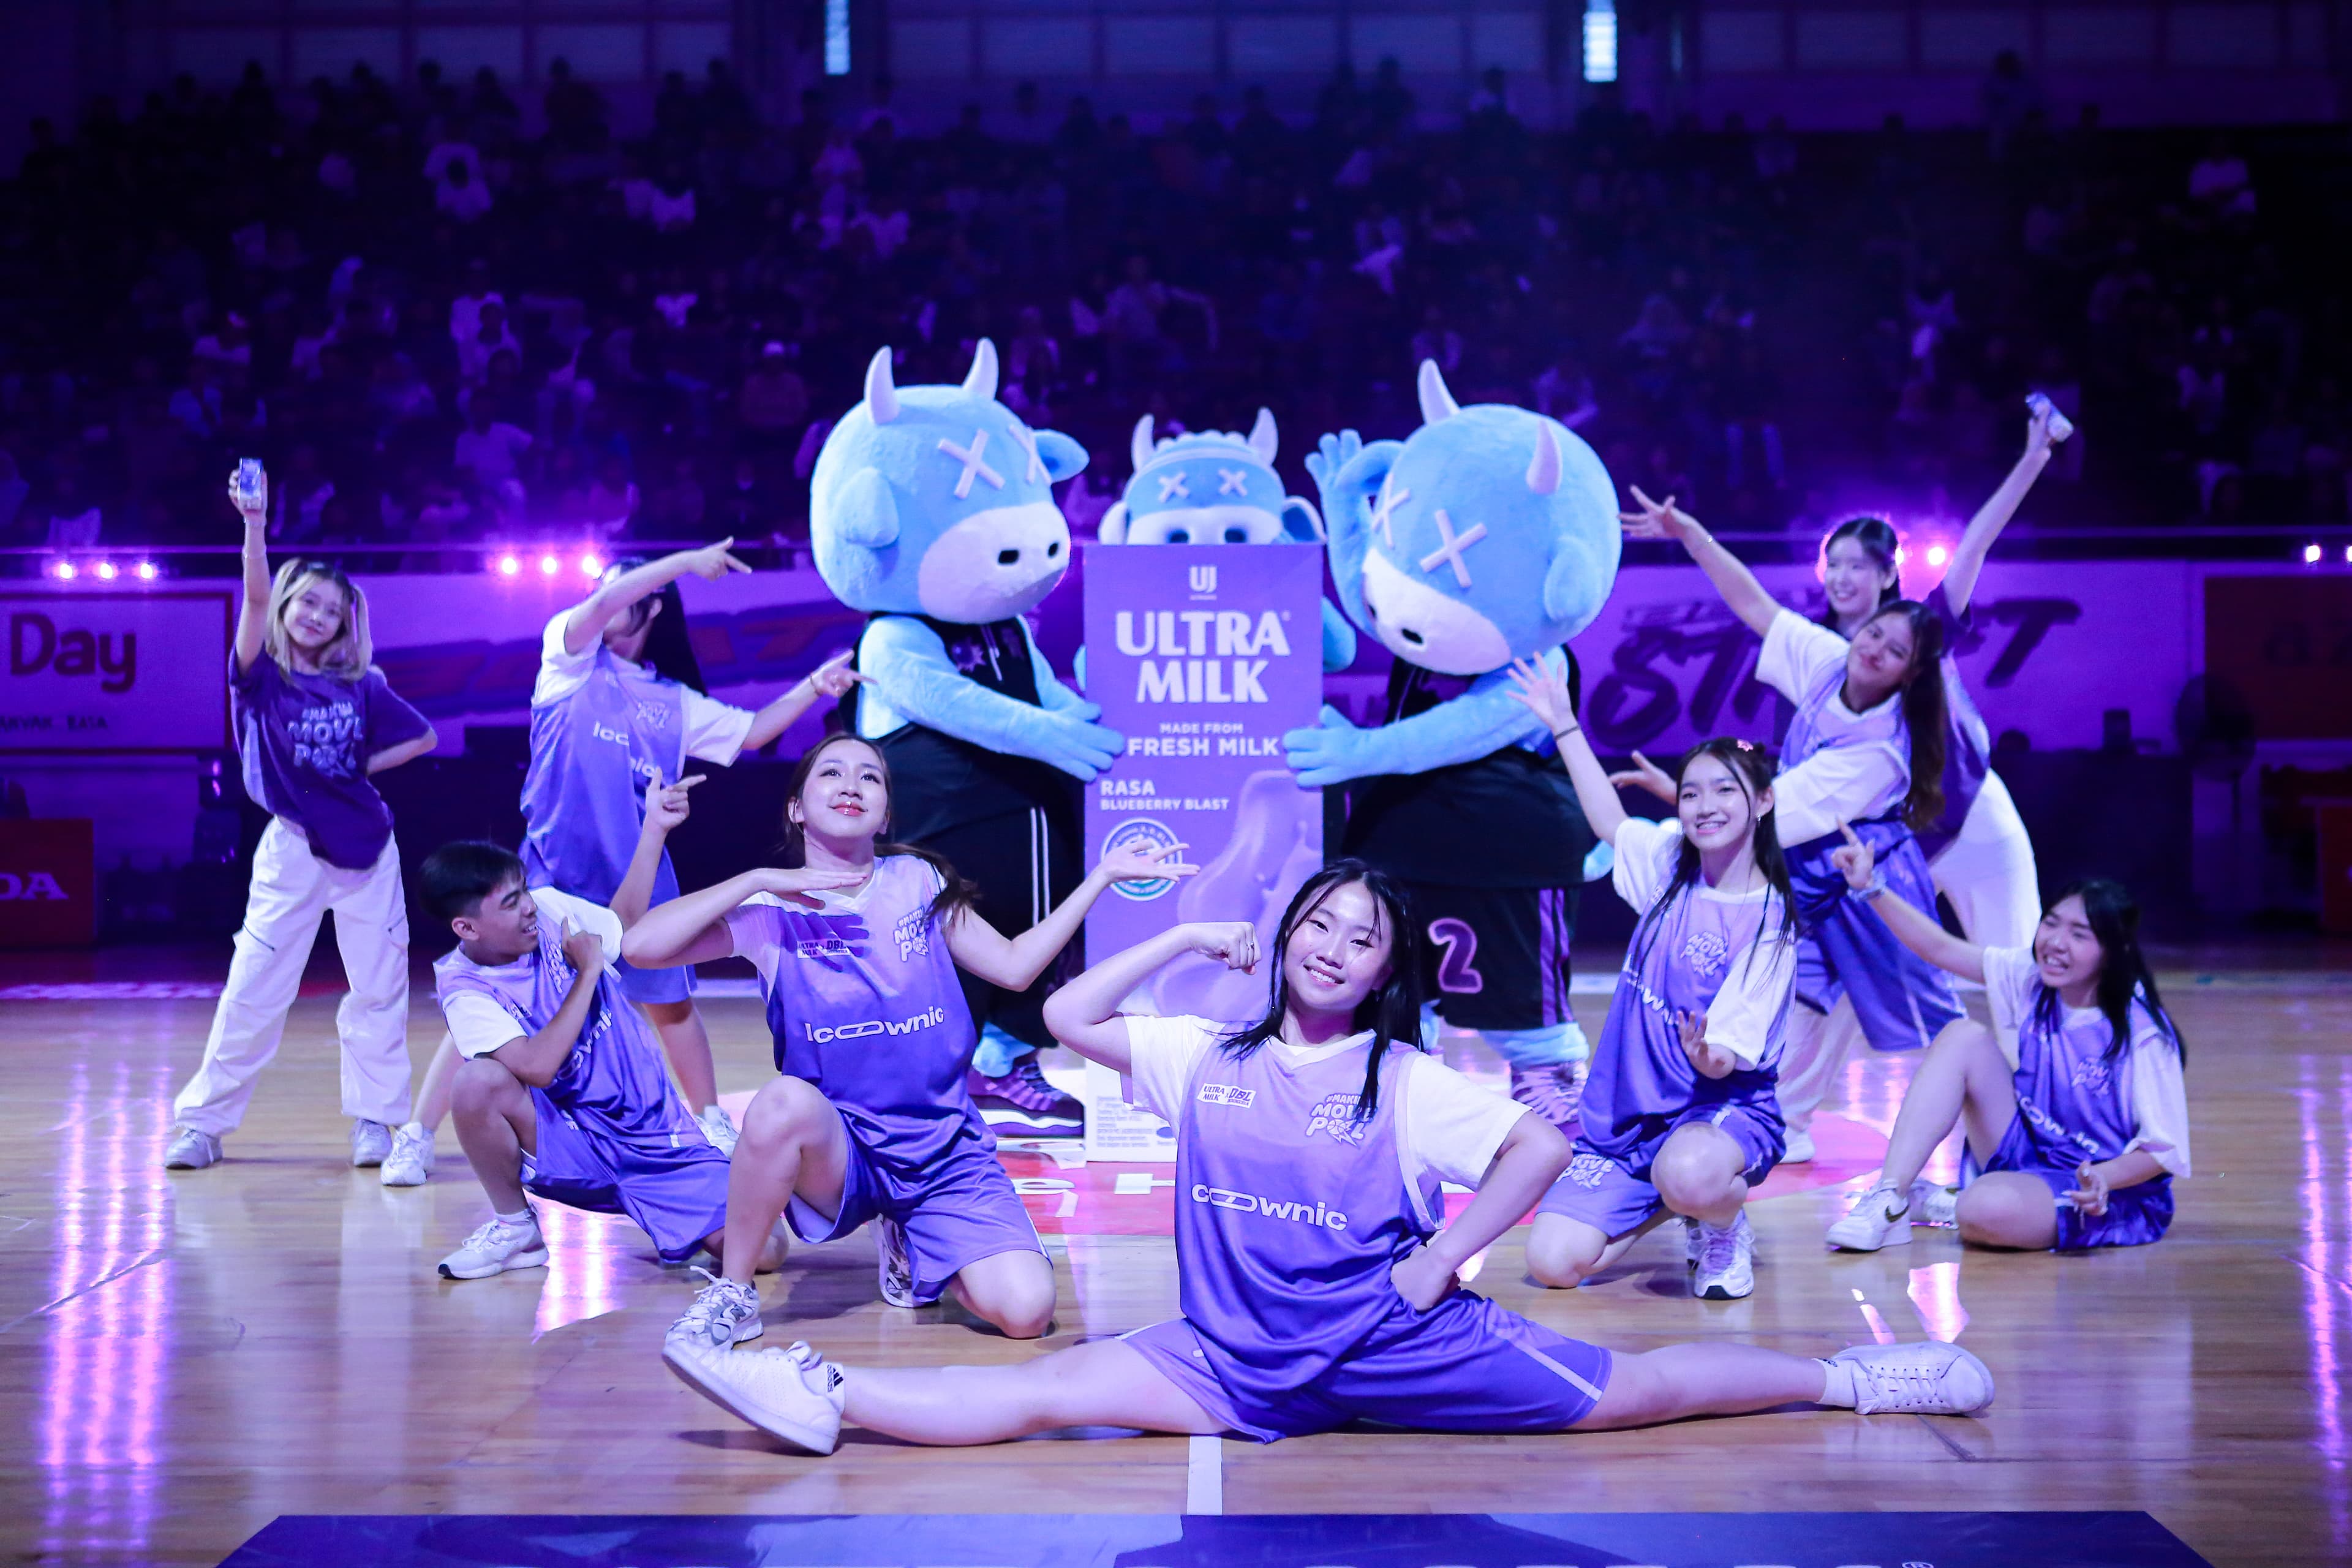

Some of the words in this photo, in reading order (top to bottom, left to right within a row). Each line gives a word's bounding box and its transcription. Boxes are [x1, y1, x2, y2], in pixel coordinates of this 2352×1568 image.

[1115, 611, 1291, 657] ULTRA
[10, 612, 137, 693] Day
[1136, 660, 1269, 704] MILK
[1160, 723, 1200, 734] MADE
[1204, 723, 1244, 734] FROM
[1128, 739, 1210, 756] FRESH
[1219, 739, 1280, 756] MILK
[1101, 781, 1156, 796] RASA
[1101, 799, 1181, 811] BLUEBERRY
[1185, 799, 1230, 810] BLAST
[1428, 918, 1483, 993] 2
[1204, 1085, 1225, 1095] ULTRA
[1229, 1087, 1251, 1102] DBL
